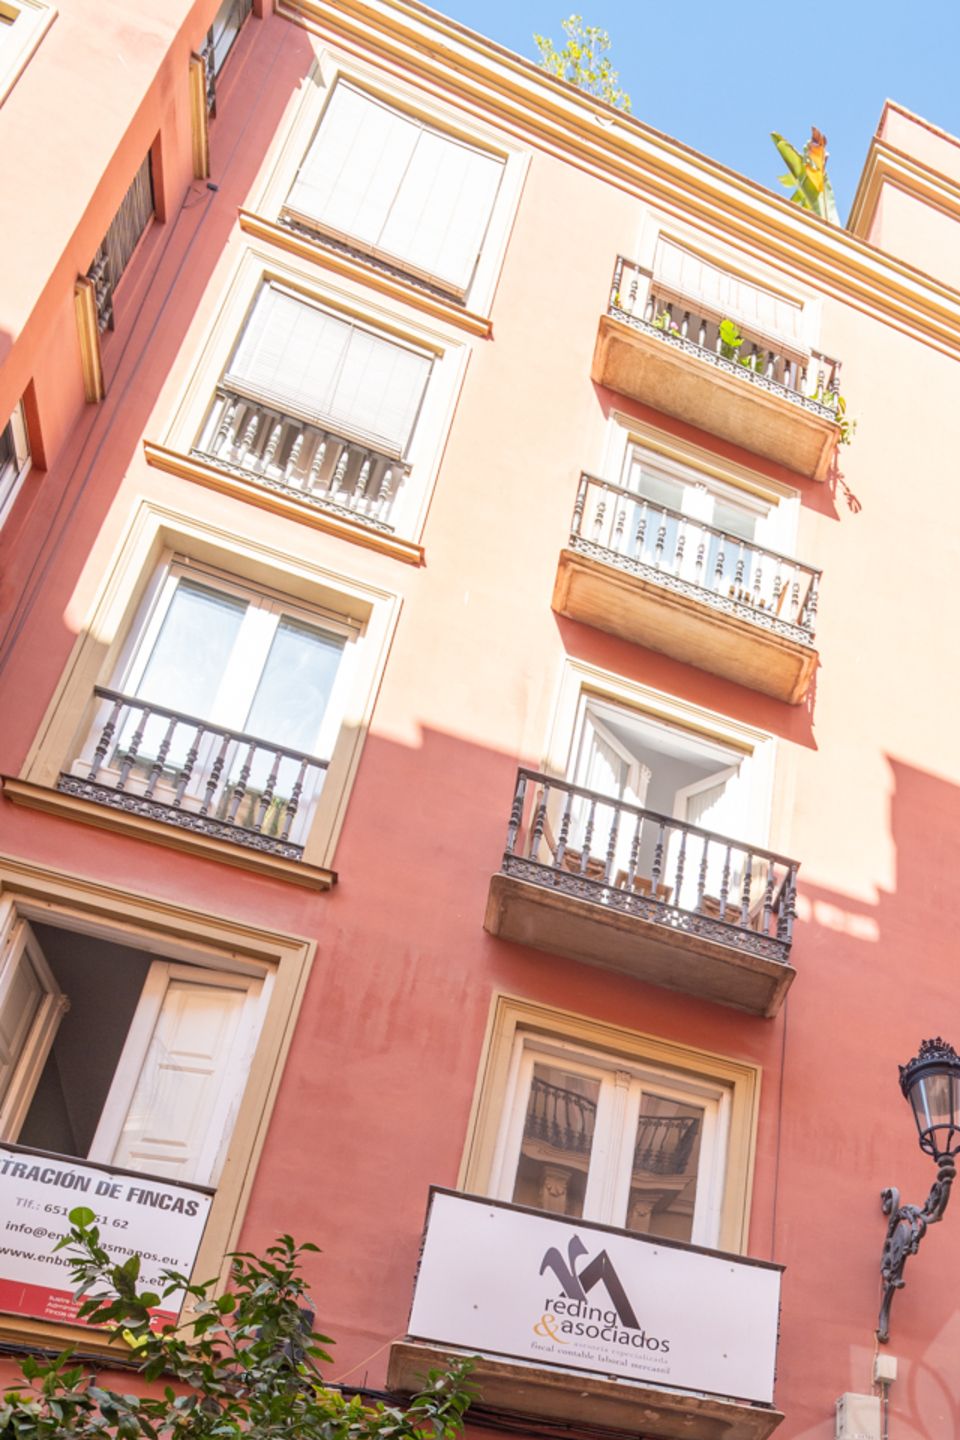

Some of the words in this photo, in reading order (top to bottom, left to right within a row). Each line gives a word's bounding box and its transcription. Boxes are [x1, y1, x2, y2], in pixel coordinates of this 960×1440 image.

[0, 1159, 92, 1192] TRACIÓN
[95, 1181, 123, 1200] DE
[126, 1187, 200, 1217] FINCAS
[44, 1204, 69, 1217] 651
[112, 1219, 129, 1230] 62
[545, 1298, 618, 1329] reding
[560, 1318, 671, 1354] asociados
